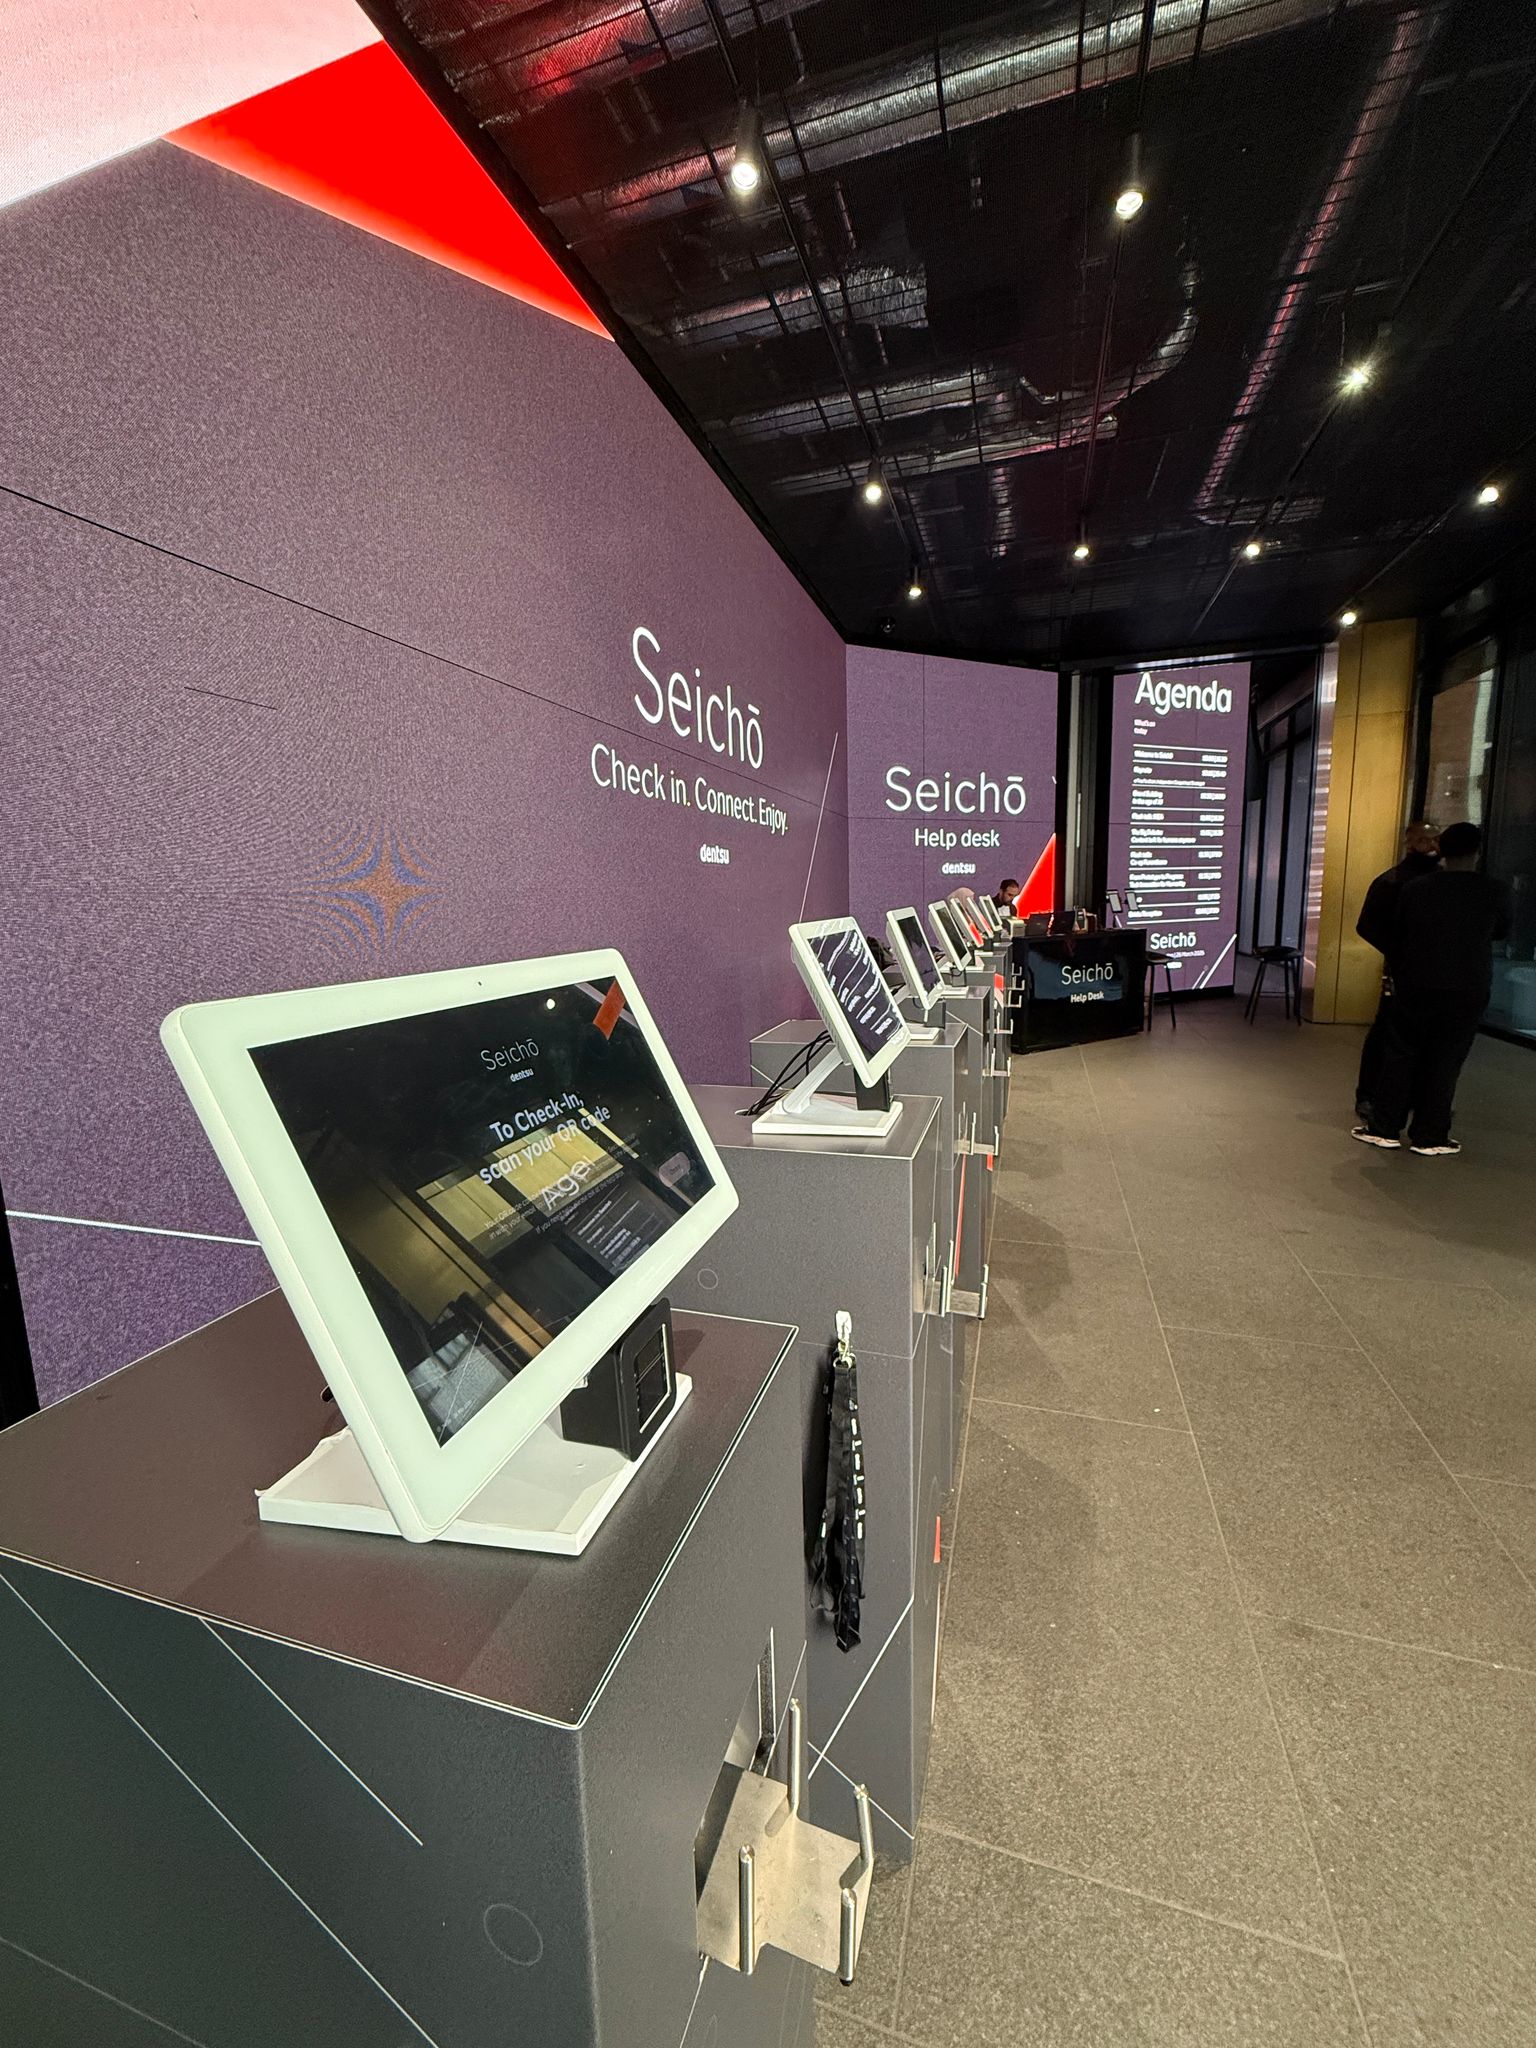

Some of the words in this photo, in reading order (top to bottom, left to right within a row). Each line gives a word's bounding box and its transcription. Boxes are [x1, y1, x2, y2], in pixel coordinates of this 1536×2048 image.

[632, 626, 763, 769] Seichō
[1134, 672, 1232, 715] Agenda
[591, 743, 666, 801] Check
[670, 770, 691, 807] in.
[695, 777, 757, 823] Connect.
[759, 797, 788, 836] Enjoy.
[885, 765, 1026, 815] Seichō
[699, 843, 730, 864] dentsu
[915, 828, 957, 851] Help
[960, 829, 1000, 848] desk
[941, 862, 976, 874] dentsu
[1150, 931, 1197, 950] Seichō
[1061, 962, 1114, 985] Seichō
[1070, 993, 1087, 1003] Help
[1087, 991, 1104, 1001] Desk
[480, 1038, 540, 1071] Seichō
[510, 1068, 534, 1083] dentsu
[489, 1121, 514, 1143] To
[514, 1092, 584, 1132] Check-In,
[479, 1152, 522, 1185] scan
[521, 1133, 556, 1166] your
[556, 1118, 581, 1142] QR
[580, 1105, 611, 1131] code
